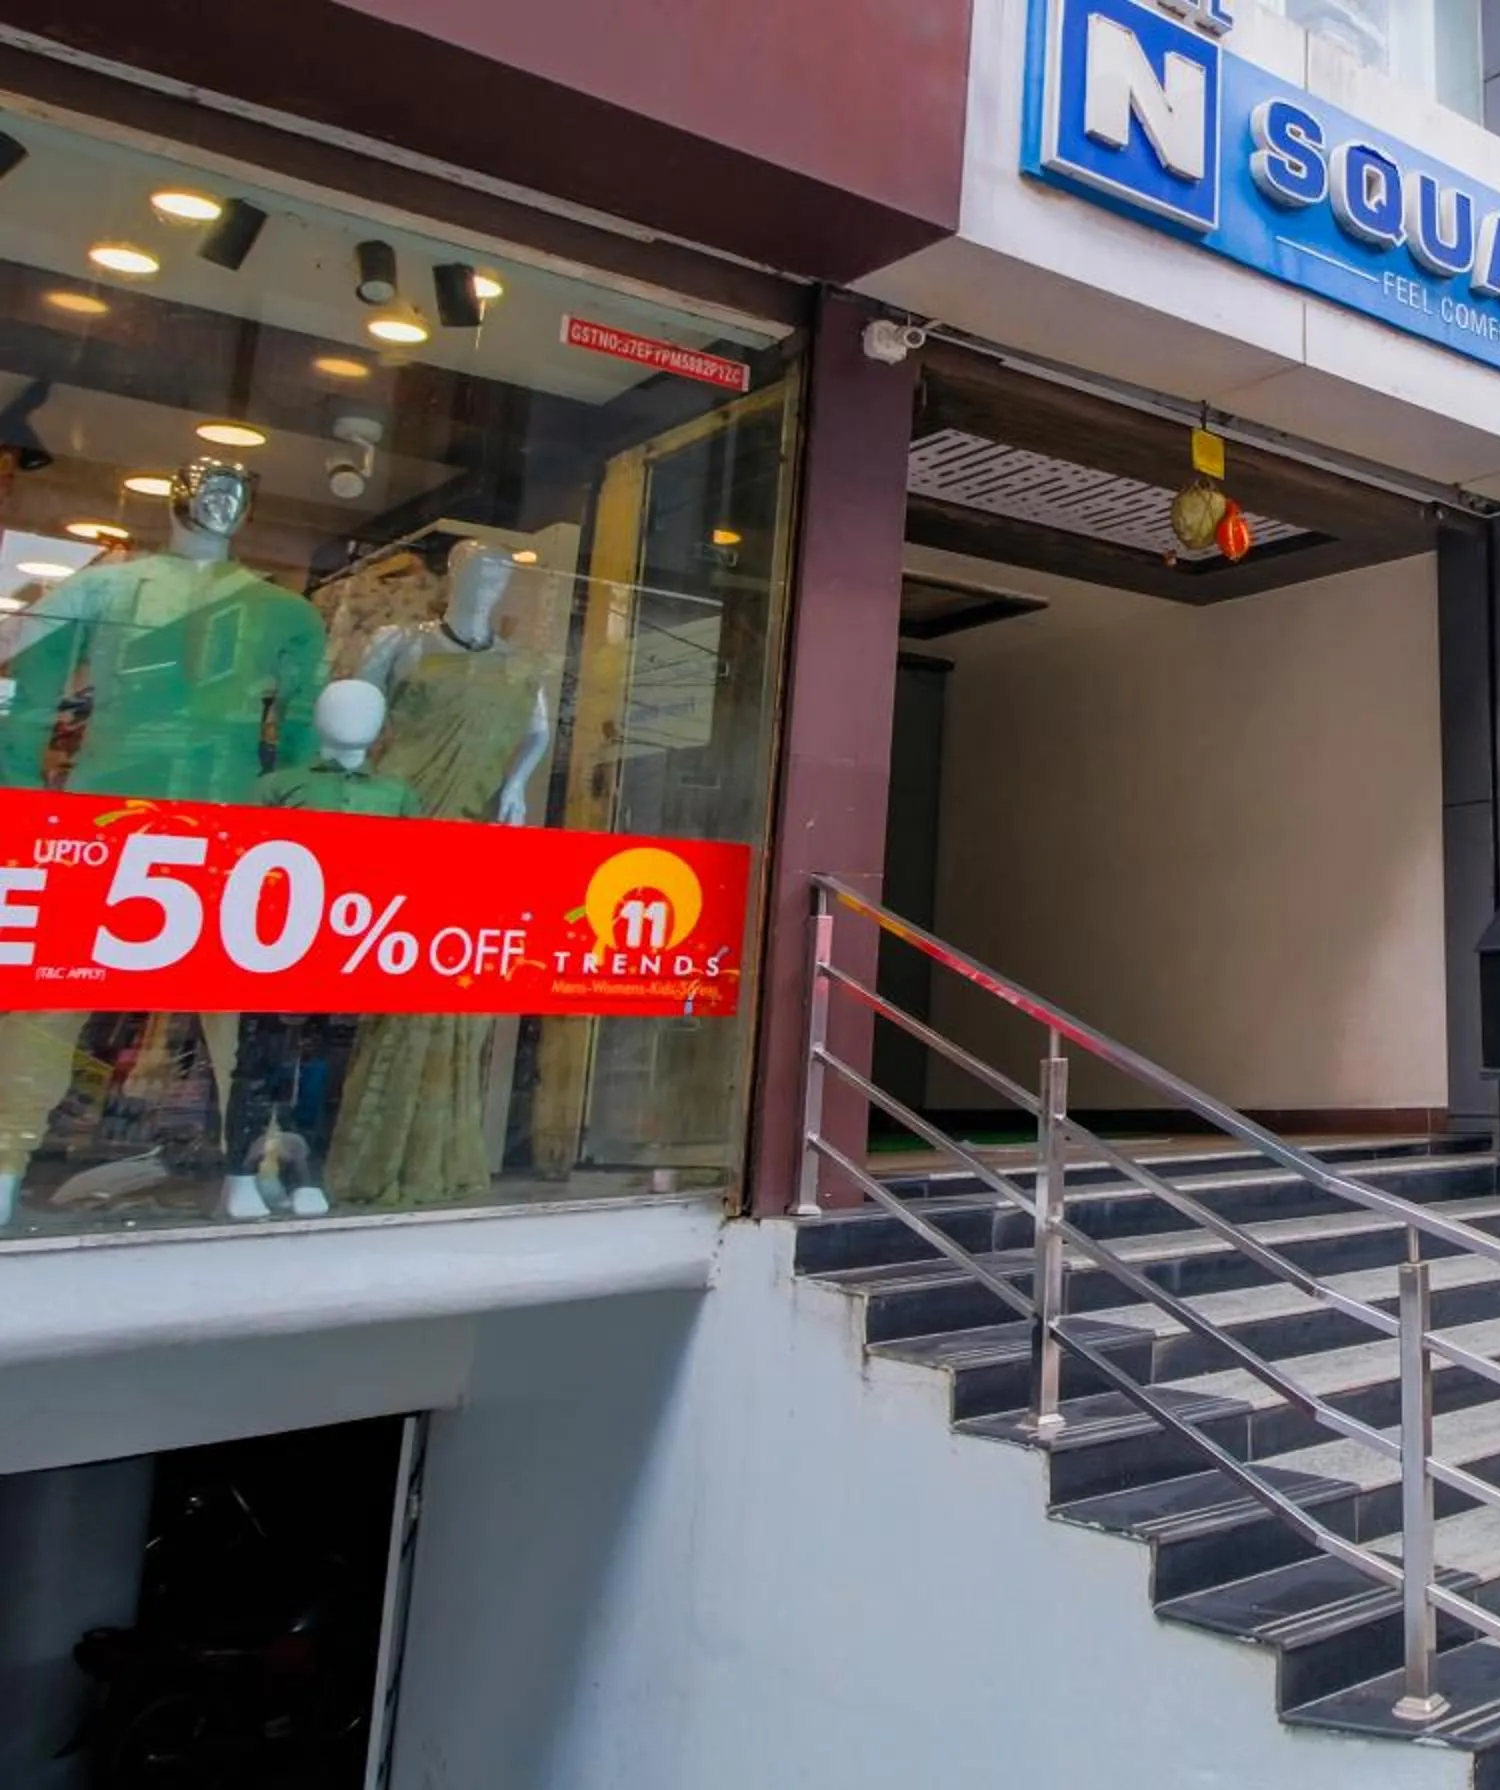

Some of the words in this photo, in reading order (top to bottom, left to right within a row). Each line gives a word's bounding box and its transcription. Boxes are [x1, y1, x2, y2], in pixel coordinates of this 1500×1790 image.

[1084, 11, 1206, 182] N
[1382, 271, 1434, 316] FEEL
[33, 838, 109, 867] UPTO
[91, 833, 420, 974] 50%
[429, 926, 527, 977] OFF
[552, 951, 720, 977] TRENDS
